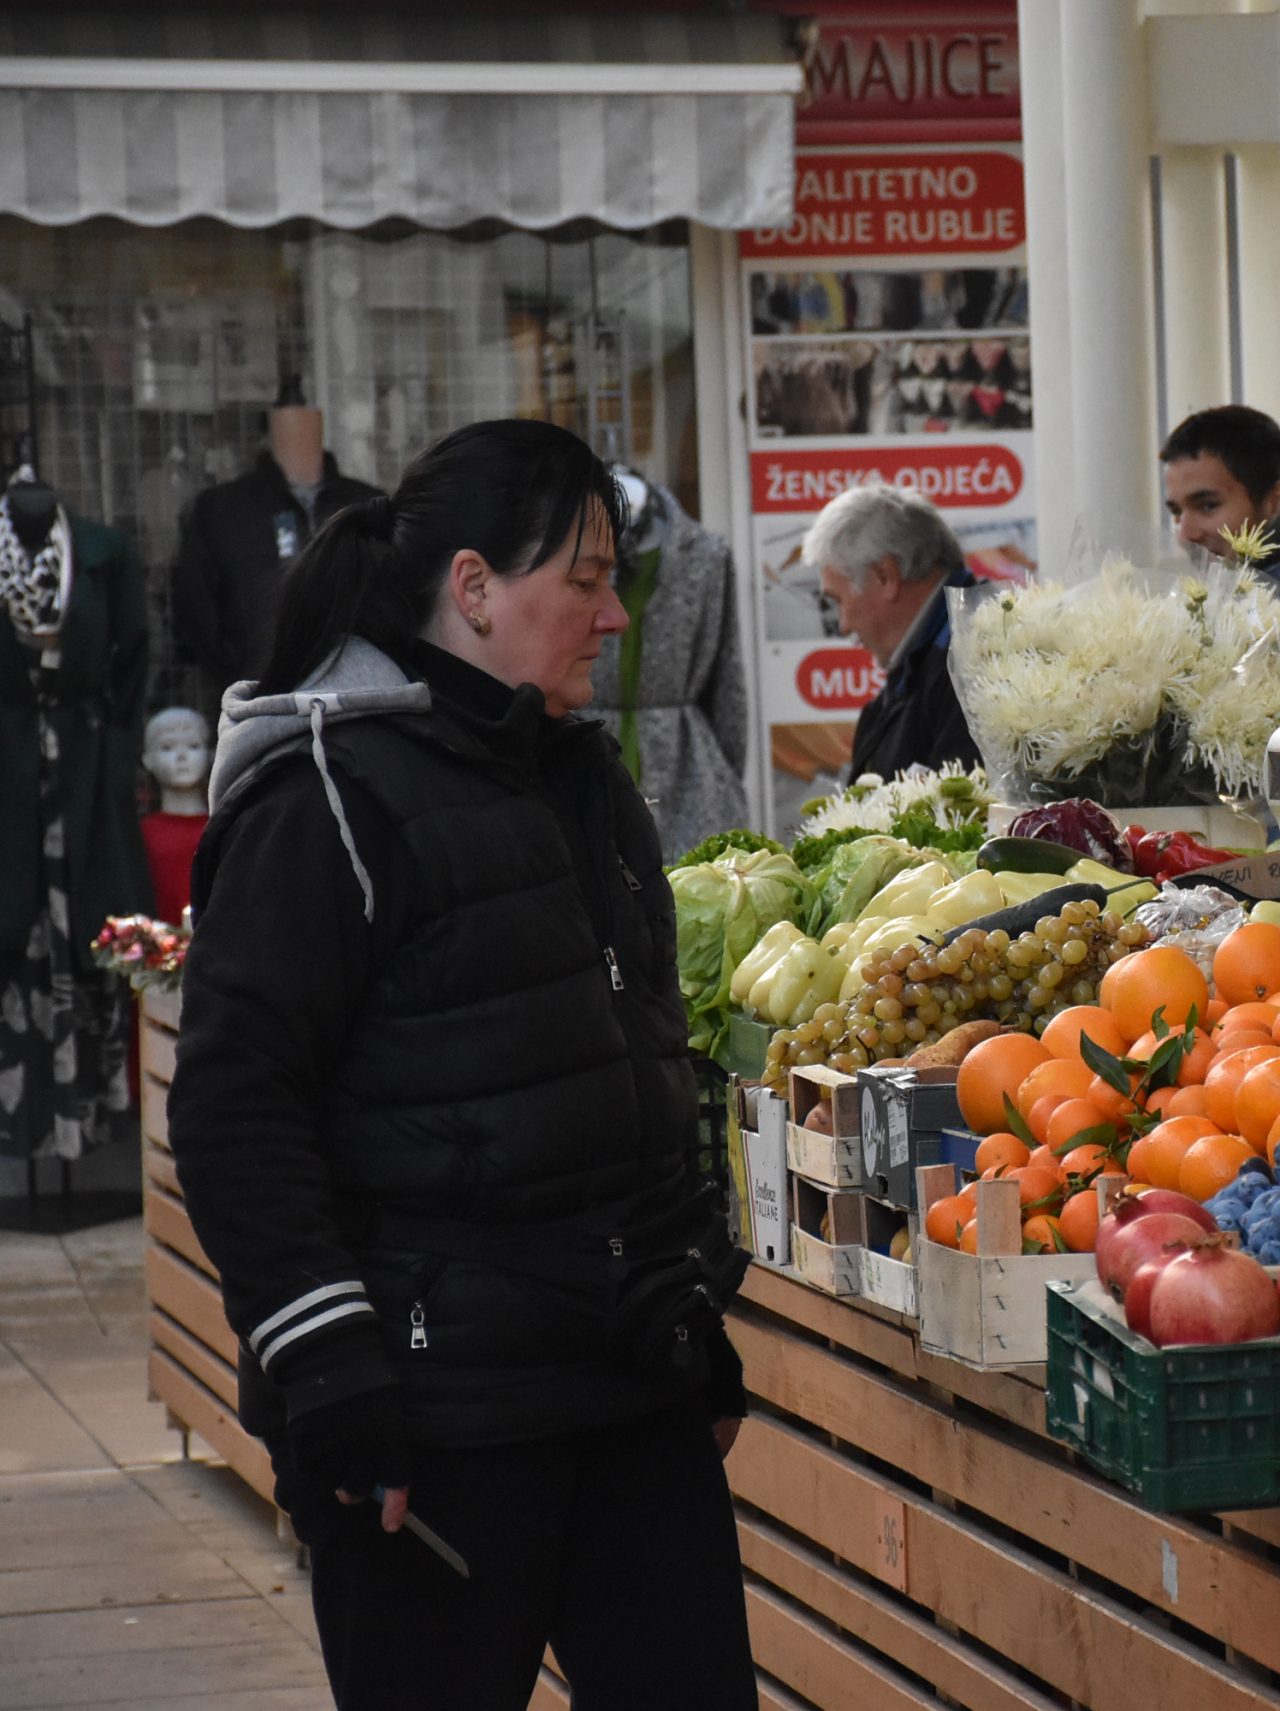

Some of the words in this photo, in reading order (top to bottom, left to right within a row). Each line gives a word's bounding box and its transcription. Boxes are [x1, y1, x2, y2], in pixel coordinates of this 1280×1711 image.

[806, 33, 1007, 103] MAJICE
[885, 207, 1015, 243] RUBLJE
[894, 457, 1014, 499] ODJEĆA
[883, 1514, 898, 1568] 96
